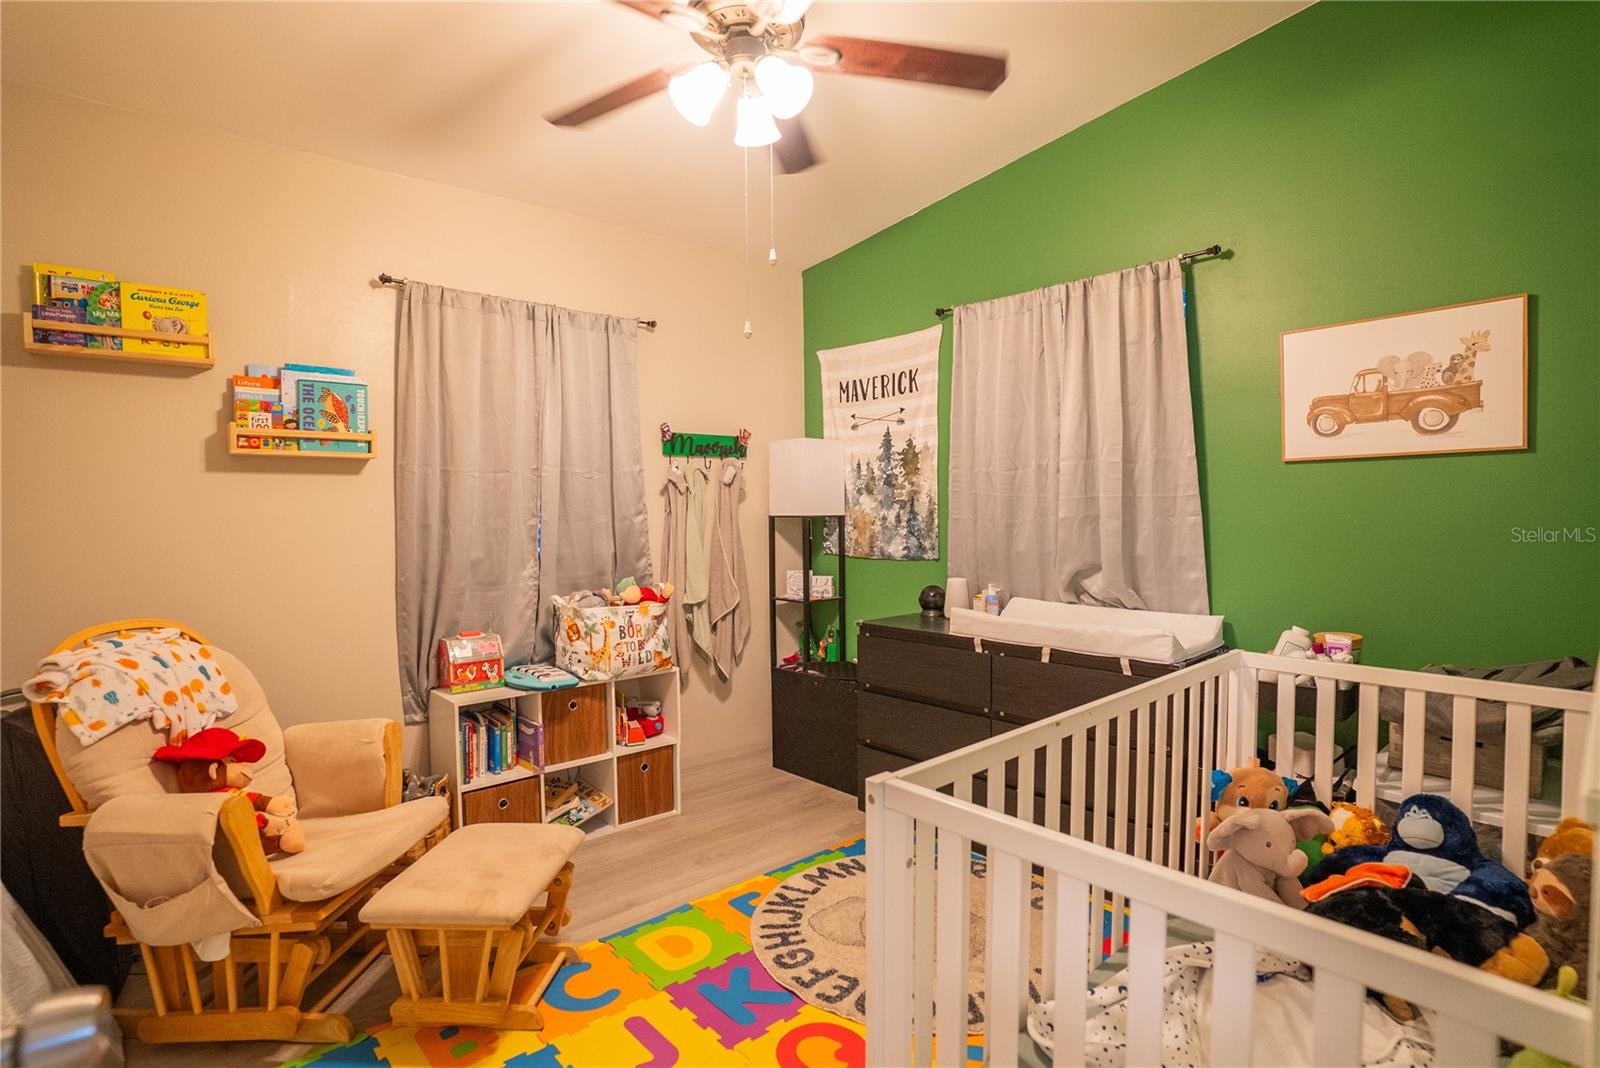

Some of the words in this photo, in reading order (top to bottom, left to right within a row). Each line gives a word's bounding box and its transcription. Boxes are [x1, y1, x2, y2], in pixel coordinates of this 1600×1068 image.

[130, 292, 167, 304] Curious
[168, 296, 200, 309] George
[302, 383, 315, 403] THE
[839, 368, 919, 404] MAVERICK
[251, 416, 269, 424] first
[618, 623, 650, 640] BORN
[624, 641, 636, 652] TO
[621, 650, 653, 668] WILD
[635, 925, 713, 972] D
[697, 966, 795, 1026] K
